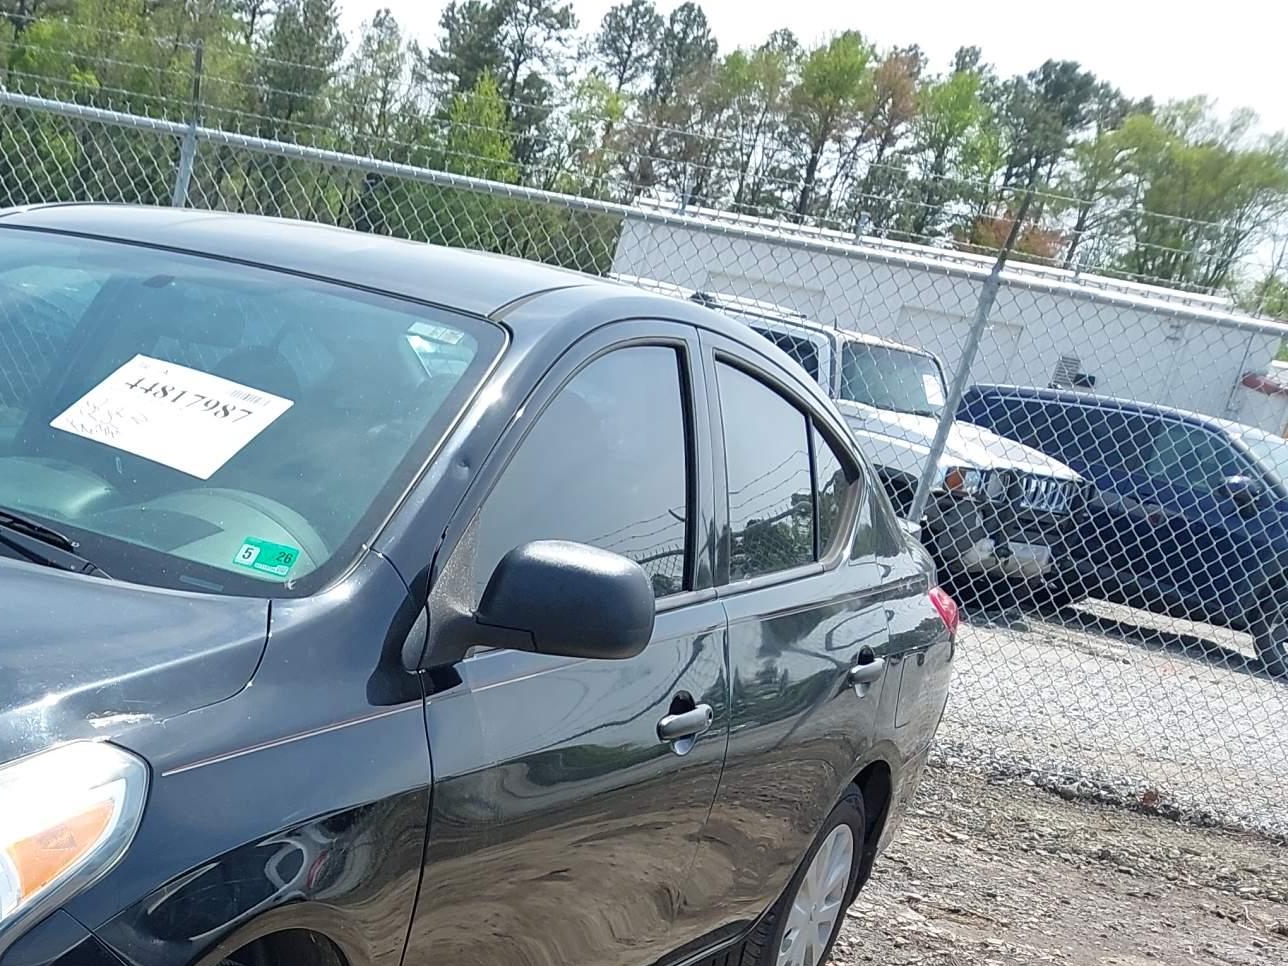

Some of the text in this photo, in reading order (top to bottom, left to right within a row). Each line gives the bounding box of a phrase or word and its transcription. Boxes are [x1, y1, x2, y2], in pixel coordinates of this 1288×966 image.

[124, 376, 254, 423] 44817987
[242, 547, 293, 564] 5 26
